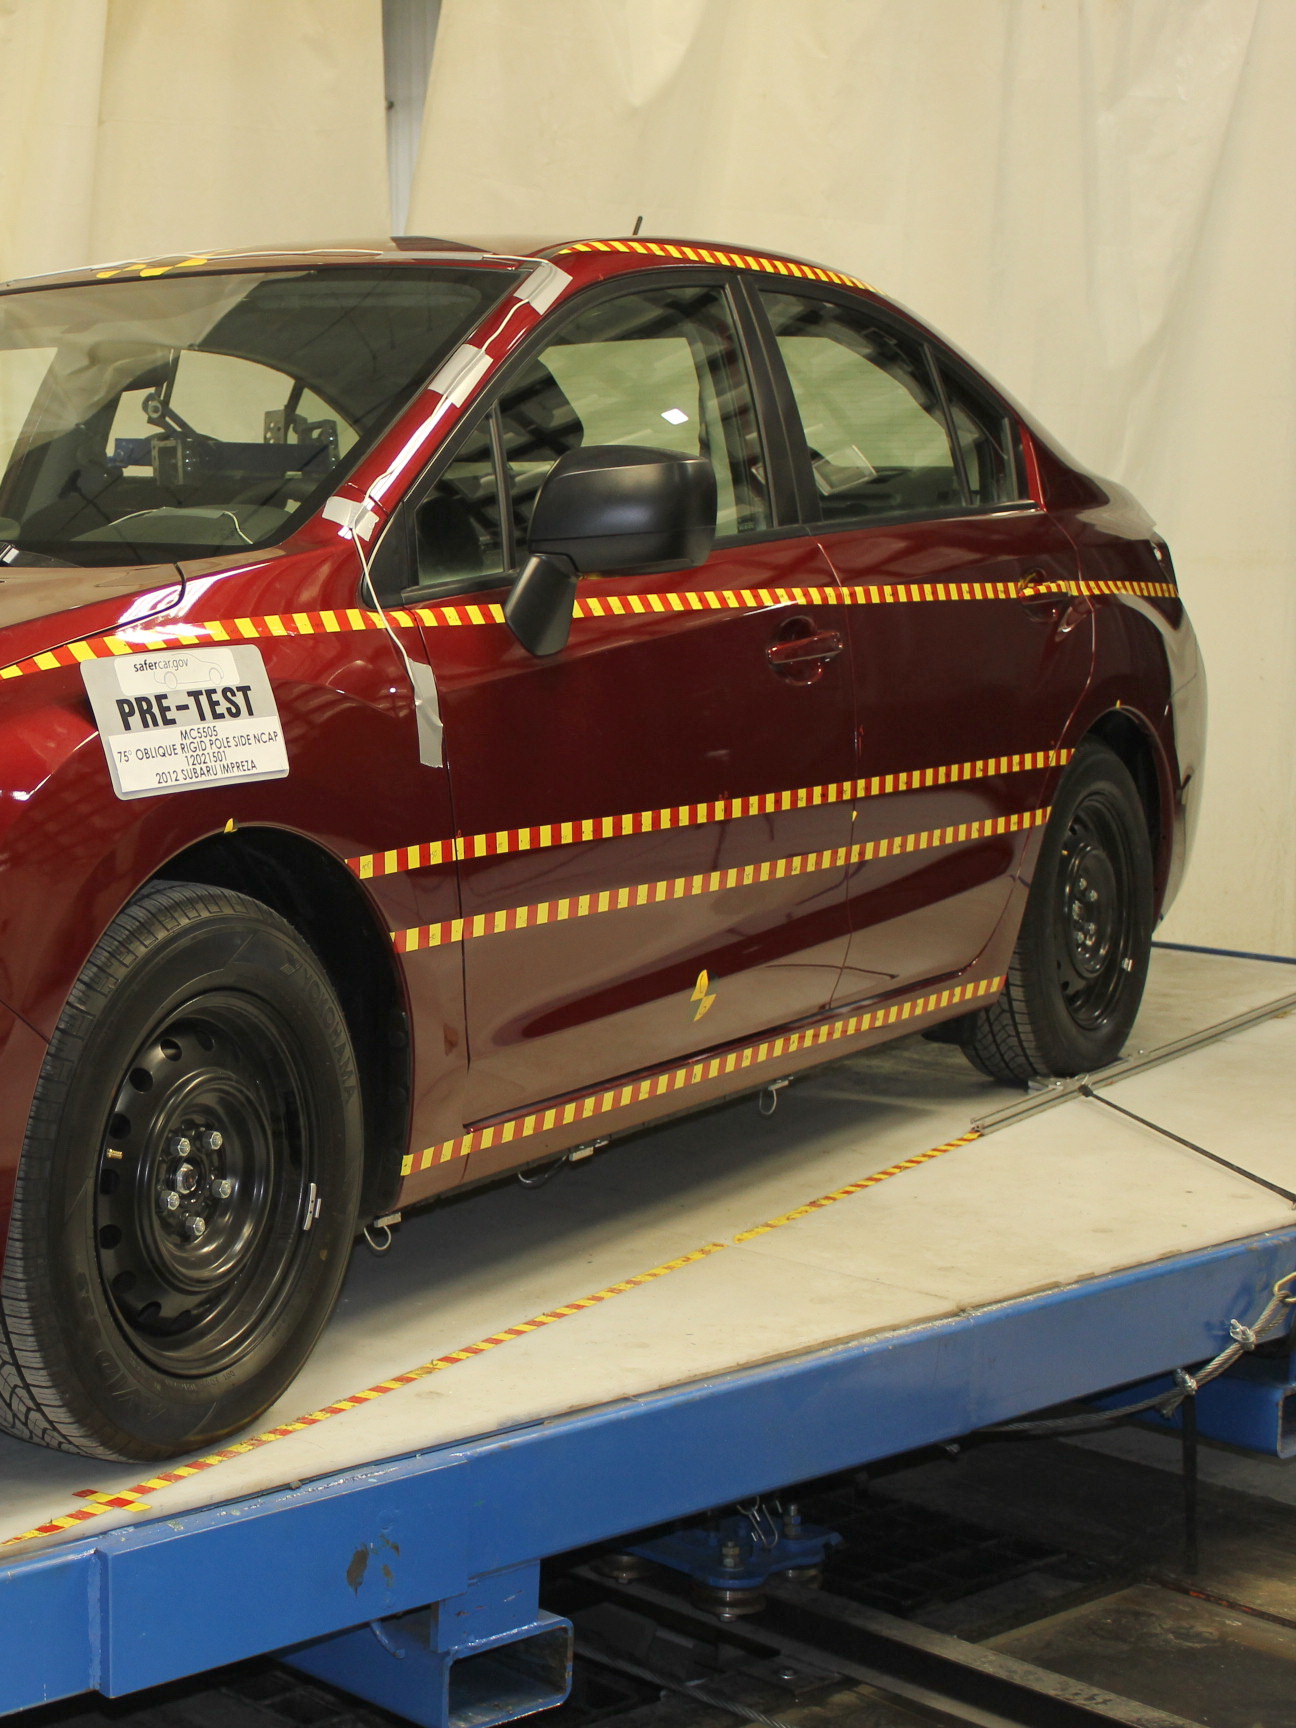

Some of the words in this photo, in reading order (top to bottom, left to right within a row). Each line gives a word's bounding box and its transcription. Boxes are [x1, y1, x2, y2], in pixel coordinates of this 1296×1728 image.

[133, 658, 189, 673] safercar.gov
[116, 685, 254, 731] PRE-TEST
[135, 744, 179, 761] OBLIQUE
[180, 740, 207, 755] RIGID
[209, 737, 232, 751] POLE
[233, 734, 252, 748] SIDE
[254, 730, 279, 745] NCAP
[180, 725, 218, 741] MC5505
[184, 750, 228, 767] 12021501
[155, 769, 180, 785] 2012
[181, 764, 218, 781] SUBARU
[220, 759, 258, 775] IMPREZA
[302, 965, 358, 1104] YOKOHAMA
